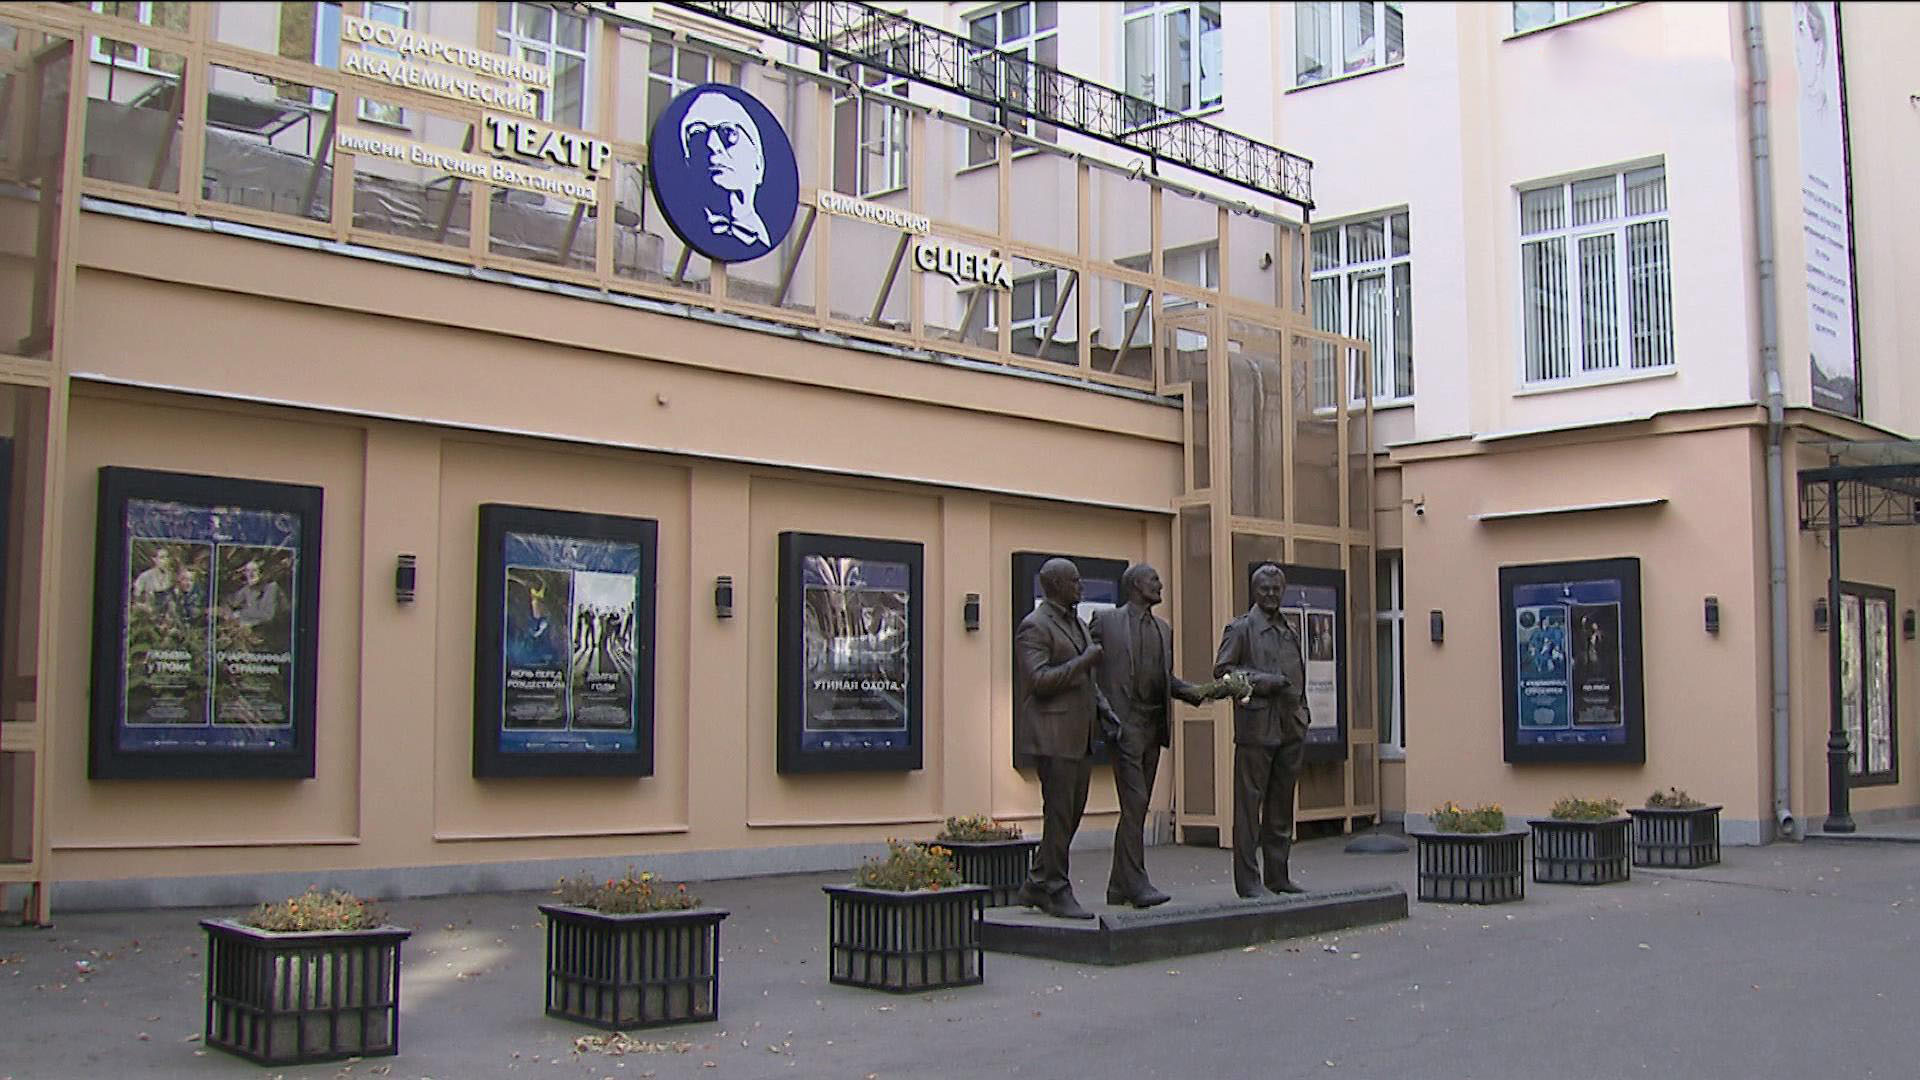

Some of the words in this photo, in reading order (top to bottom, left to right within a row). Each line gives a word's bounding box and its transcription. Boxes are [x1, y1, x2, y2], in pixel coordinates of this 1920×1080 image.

[345, 18, 550, 87] ГОСУДАРСТВЕННЫЙ
[345, 53, 534, 115] АКАДЕМИЧЕСКИЙ
[339, 132, 404, 161] имени
[409, 144, 487, 178] Евгения
[491, 160, 595, 202] Вахтангова
[487, 116, 612, 172] ТЕАТР
[819, 193, 930, 233] СИМОНОВСКАЯ
[914, 239, 1013, 290] СЦЕНА
[814, 680, 859, 690] УТИНАЯ
[861, 680, 897, 690] ОХОТА
